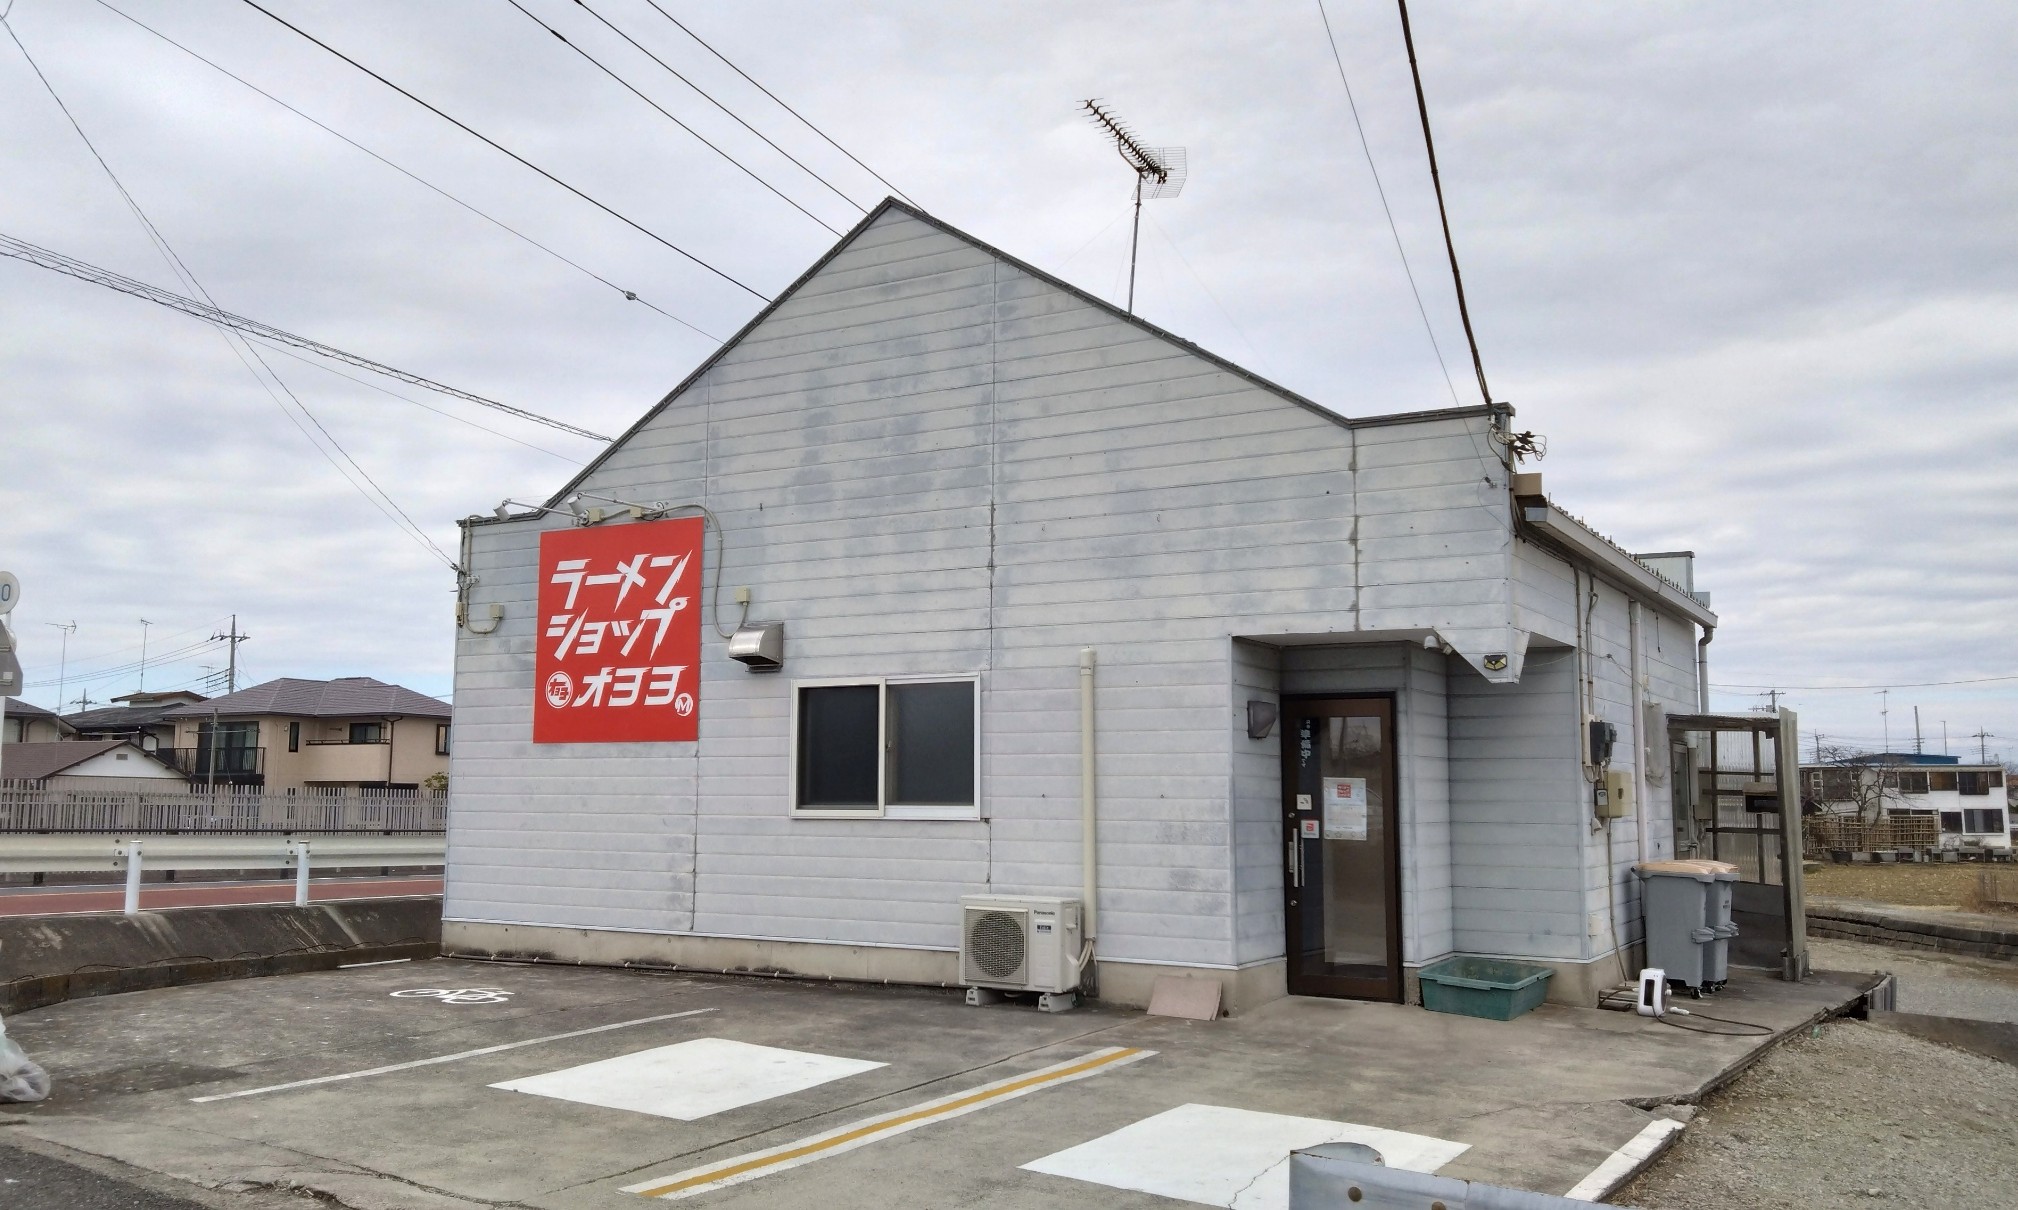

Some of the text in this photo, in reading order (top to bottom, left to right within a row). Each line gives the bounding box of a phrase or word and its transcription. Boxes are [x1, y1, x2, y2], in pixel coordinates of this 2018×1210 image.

[550, 549, 693, 613] ラーメン
[545, 596, 691, 661] ショップ
[571, 665, 690, 707] オヨヨ
